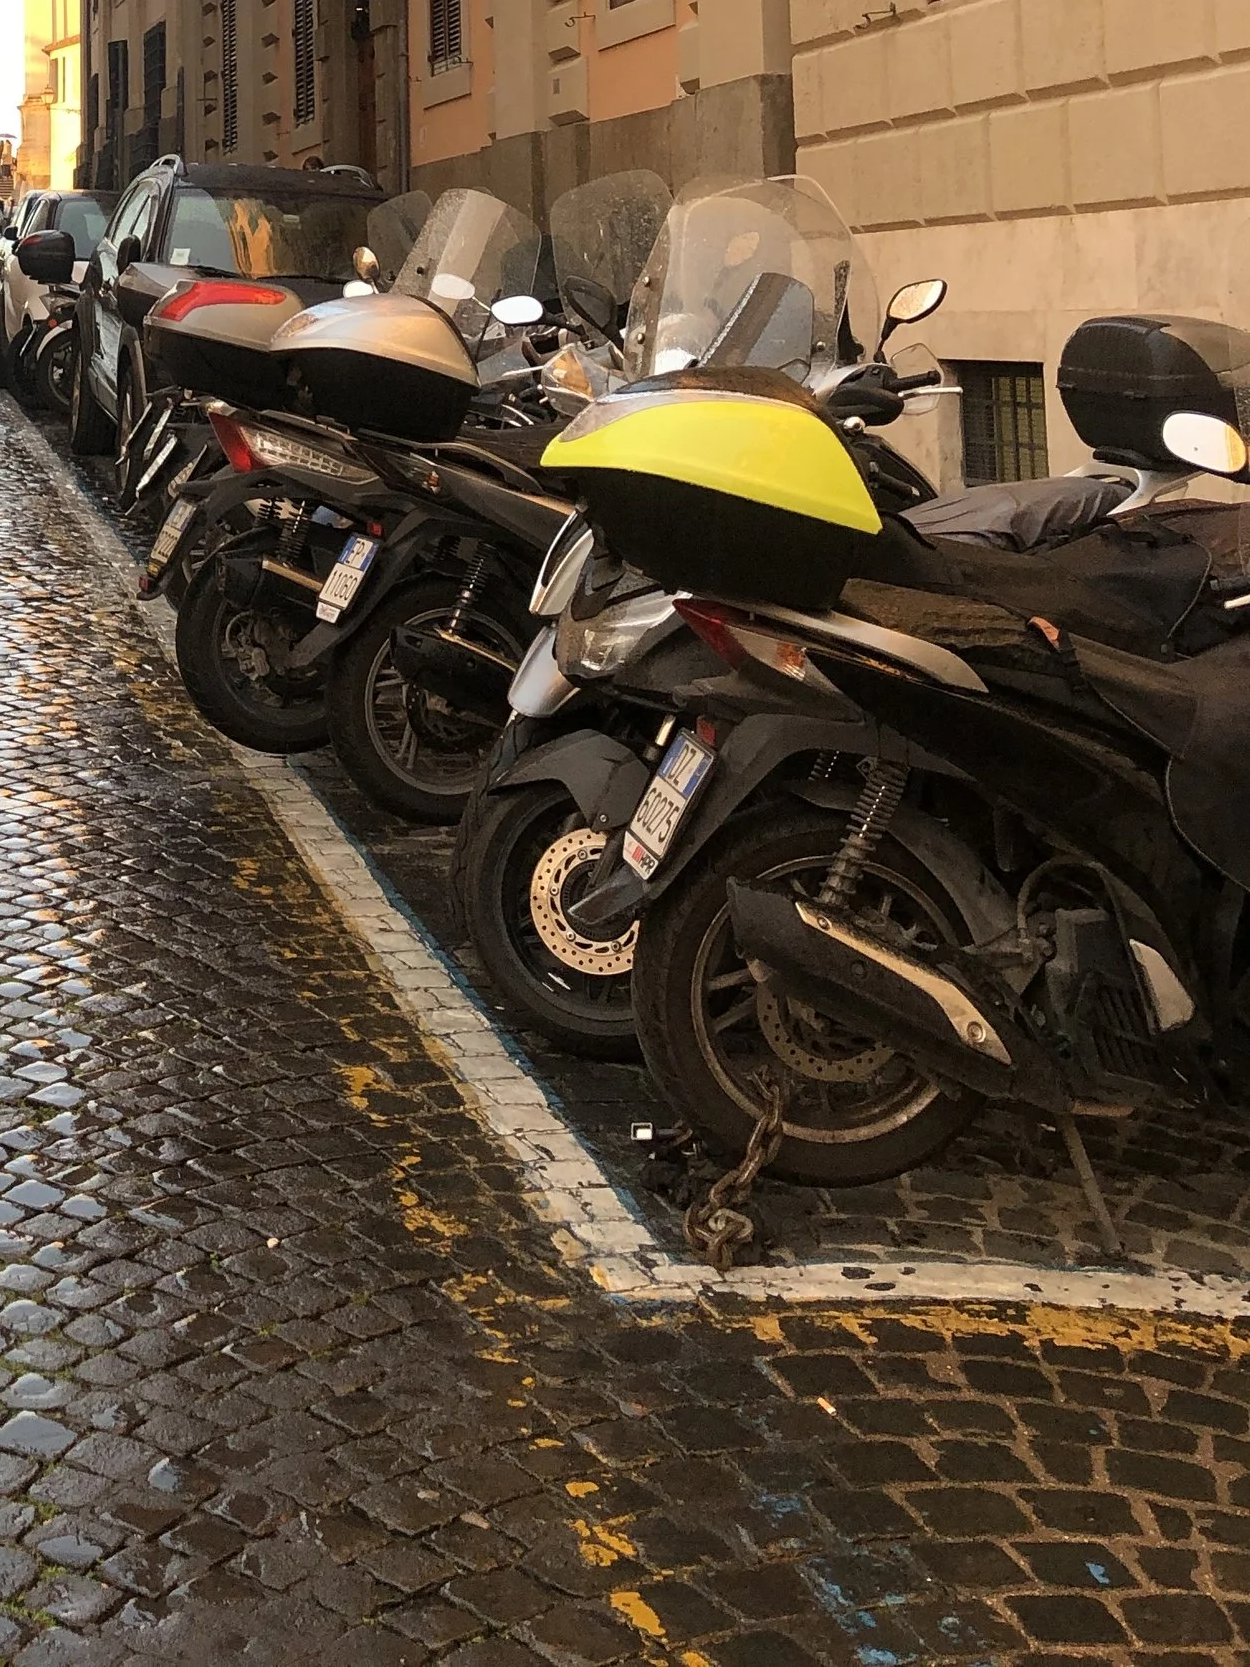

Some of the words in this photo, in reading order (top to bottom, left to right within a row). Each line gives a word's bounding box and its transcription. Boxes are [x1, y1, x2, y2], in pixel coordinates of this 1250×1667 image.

[345, 540, 366, 564] EP
[325, 570, 358, 601] 11060
[668, 743, 697, 786] DZ
[637, 787, 680, 843] 60275
